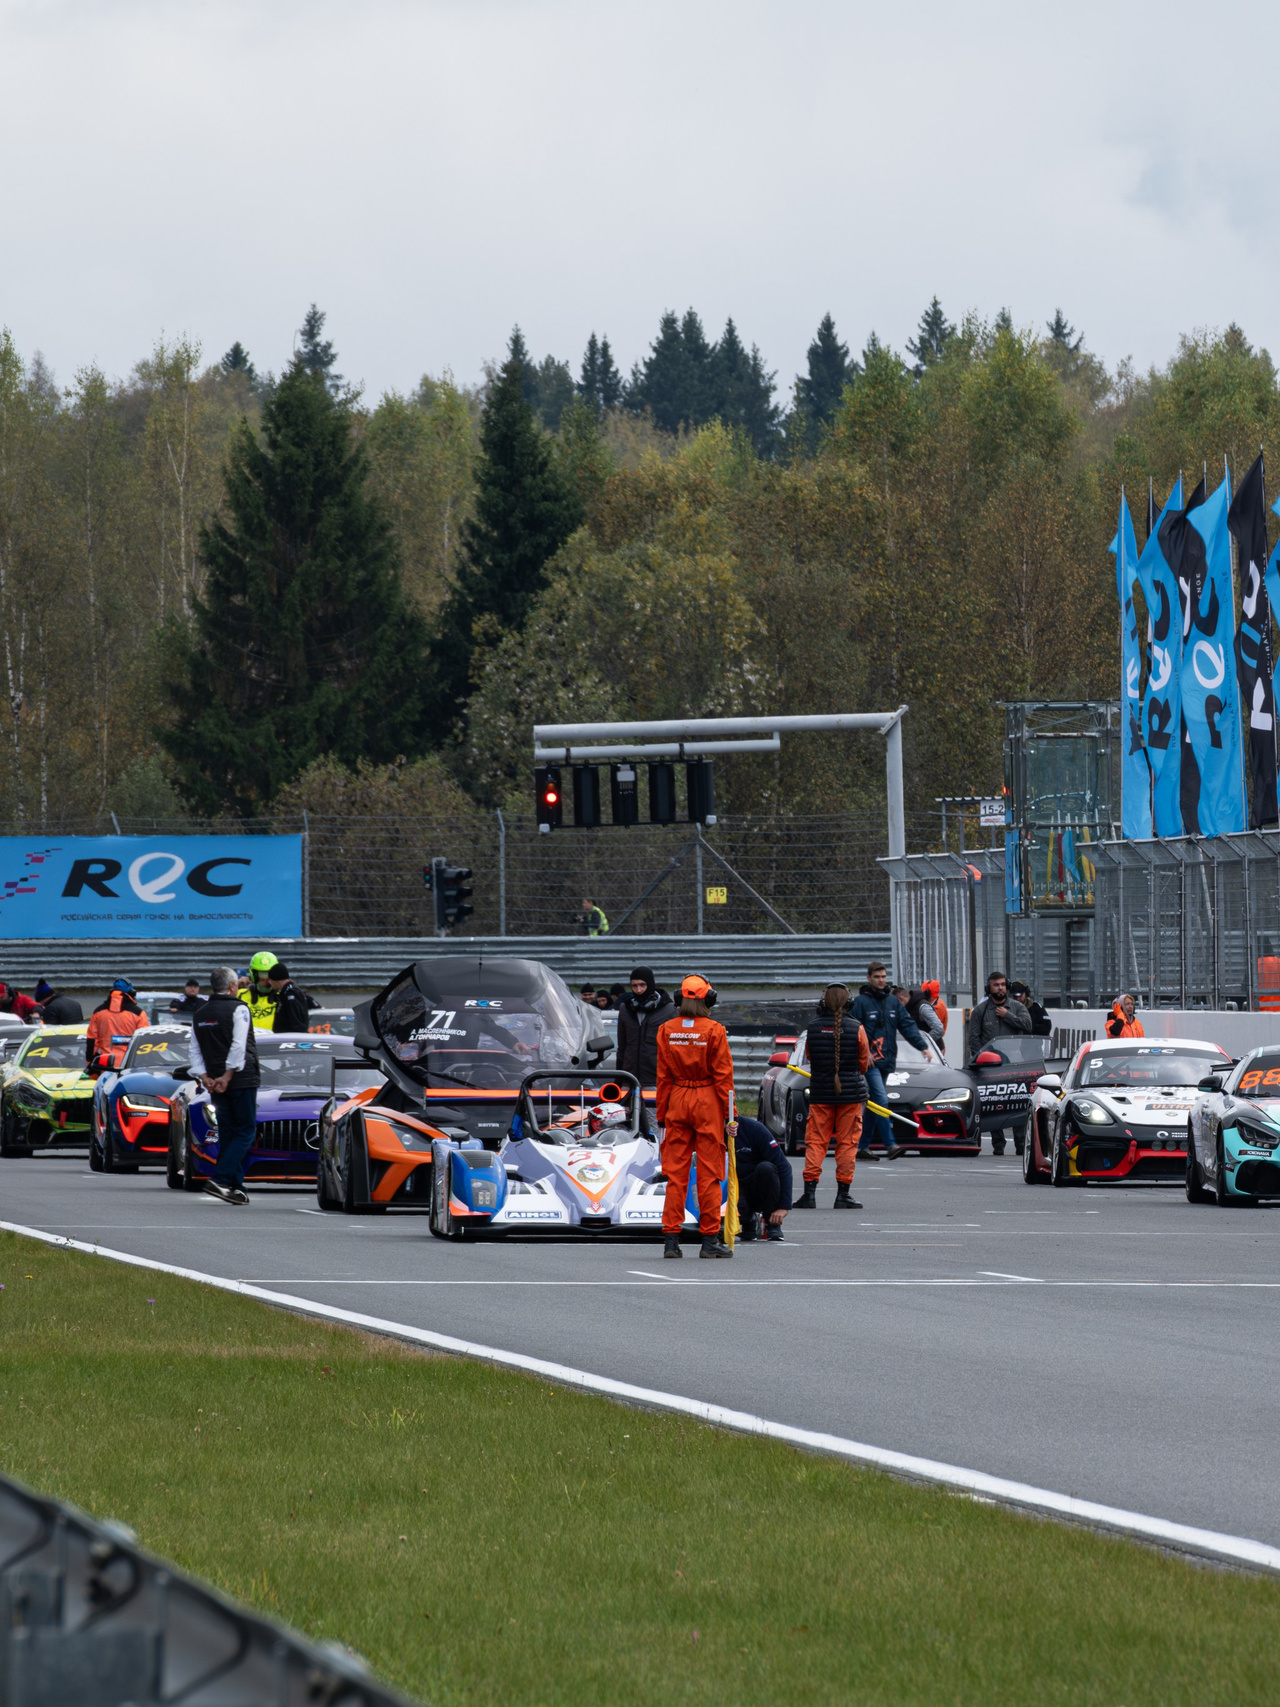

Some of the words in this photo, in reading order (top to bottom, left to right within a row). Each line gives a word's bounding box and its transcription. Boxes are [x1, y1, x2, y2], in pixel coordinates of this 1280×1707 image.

[982, 804, 1004, 815] 15-2
[708, 888, 725, 897] F15
[426, 1010, 456, 1029] 71
[27, 1047, 50, 1058] 4
[136, 1042, 168, 1055] 34
[1090, 1058, 1103, 1069] 5
